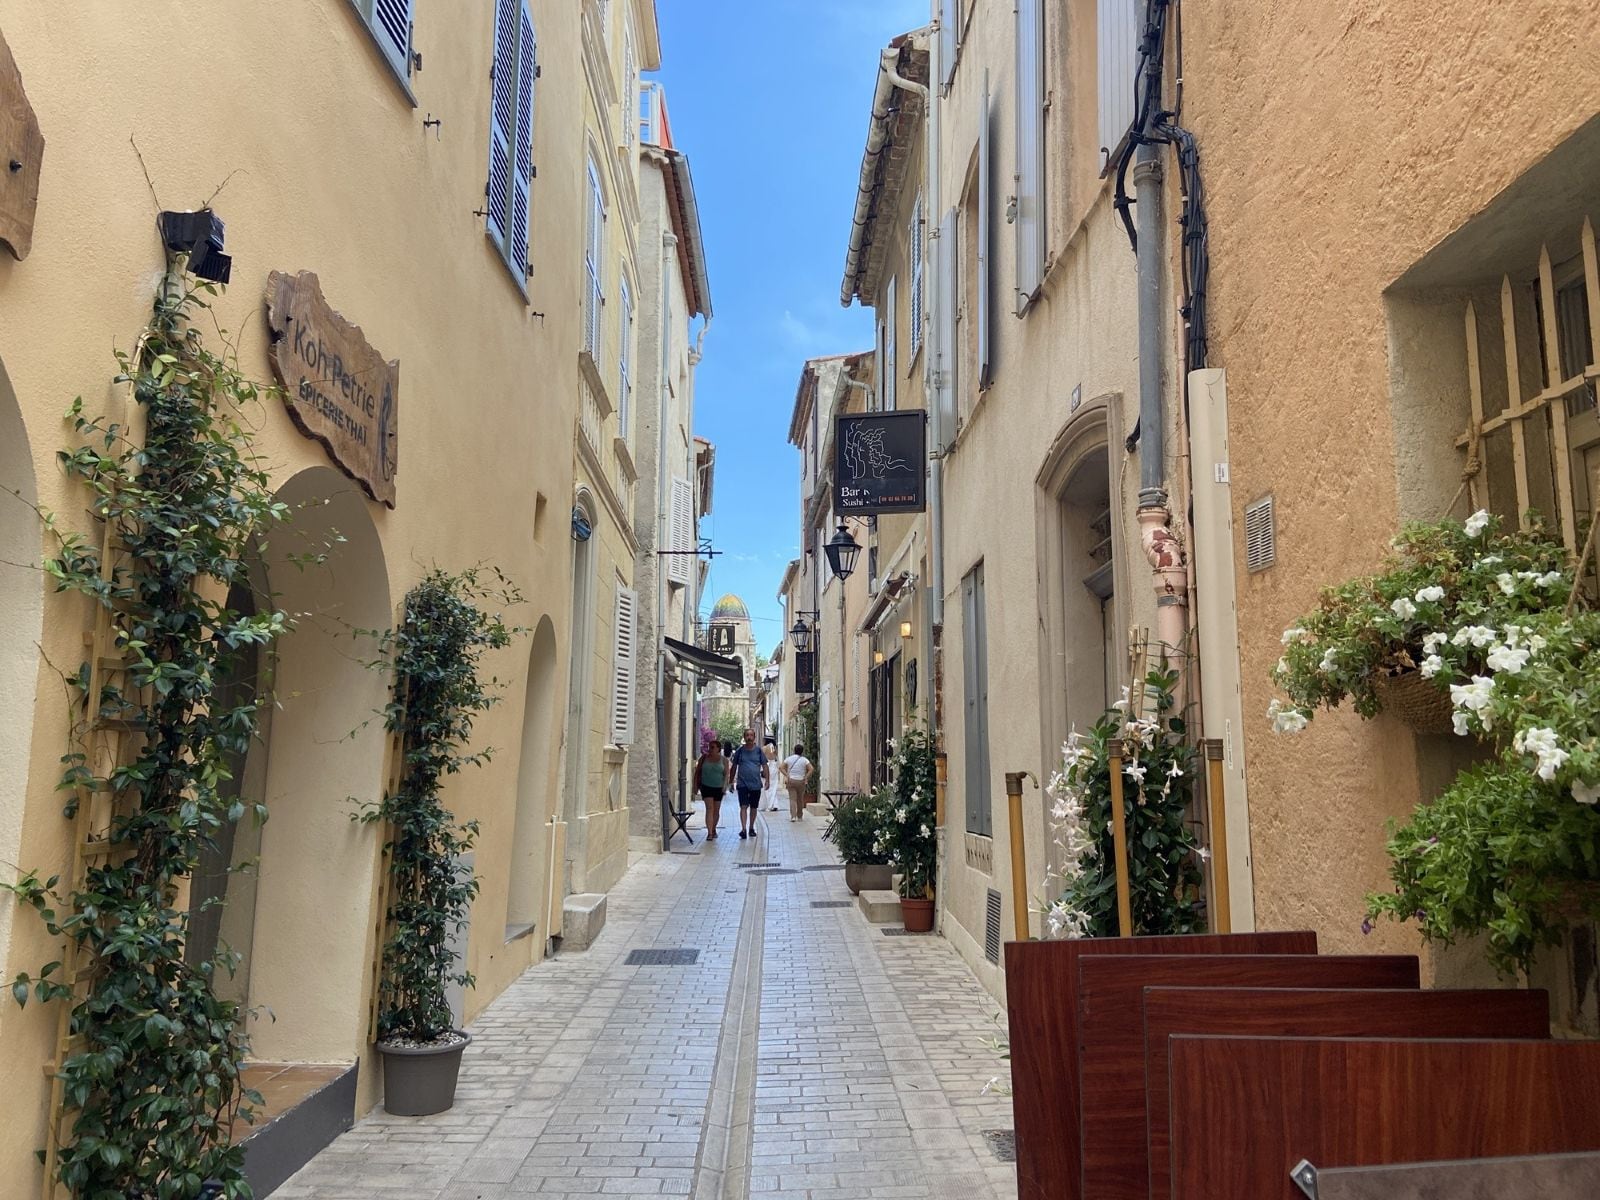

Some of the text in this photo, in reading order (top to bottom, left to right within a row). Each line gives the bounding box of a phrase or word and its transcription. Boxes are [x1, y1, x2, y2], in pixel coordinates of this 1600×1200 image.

[294, 319, 375, 419] Koh Petrie
[841, 486, 861, 497] Bar
[842, 498, 864, 507] Sushi
